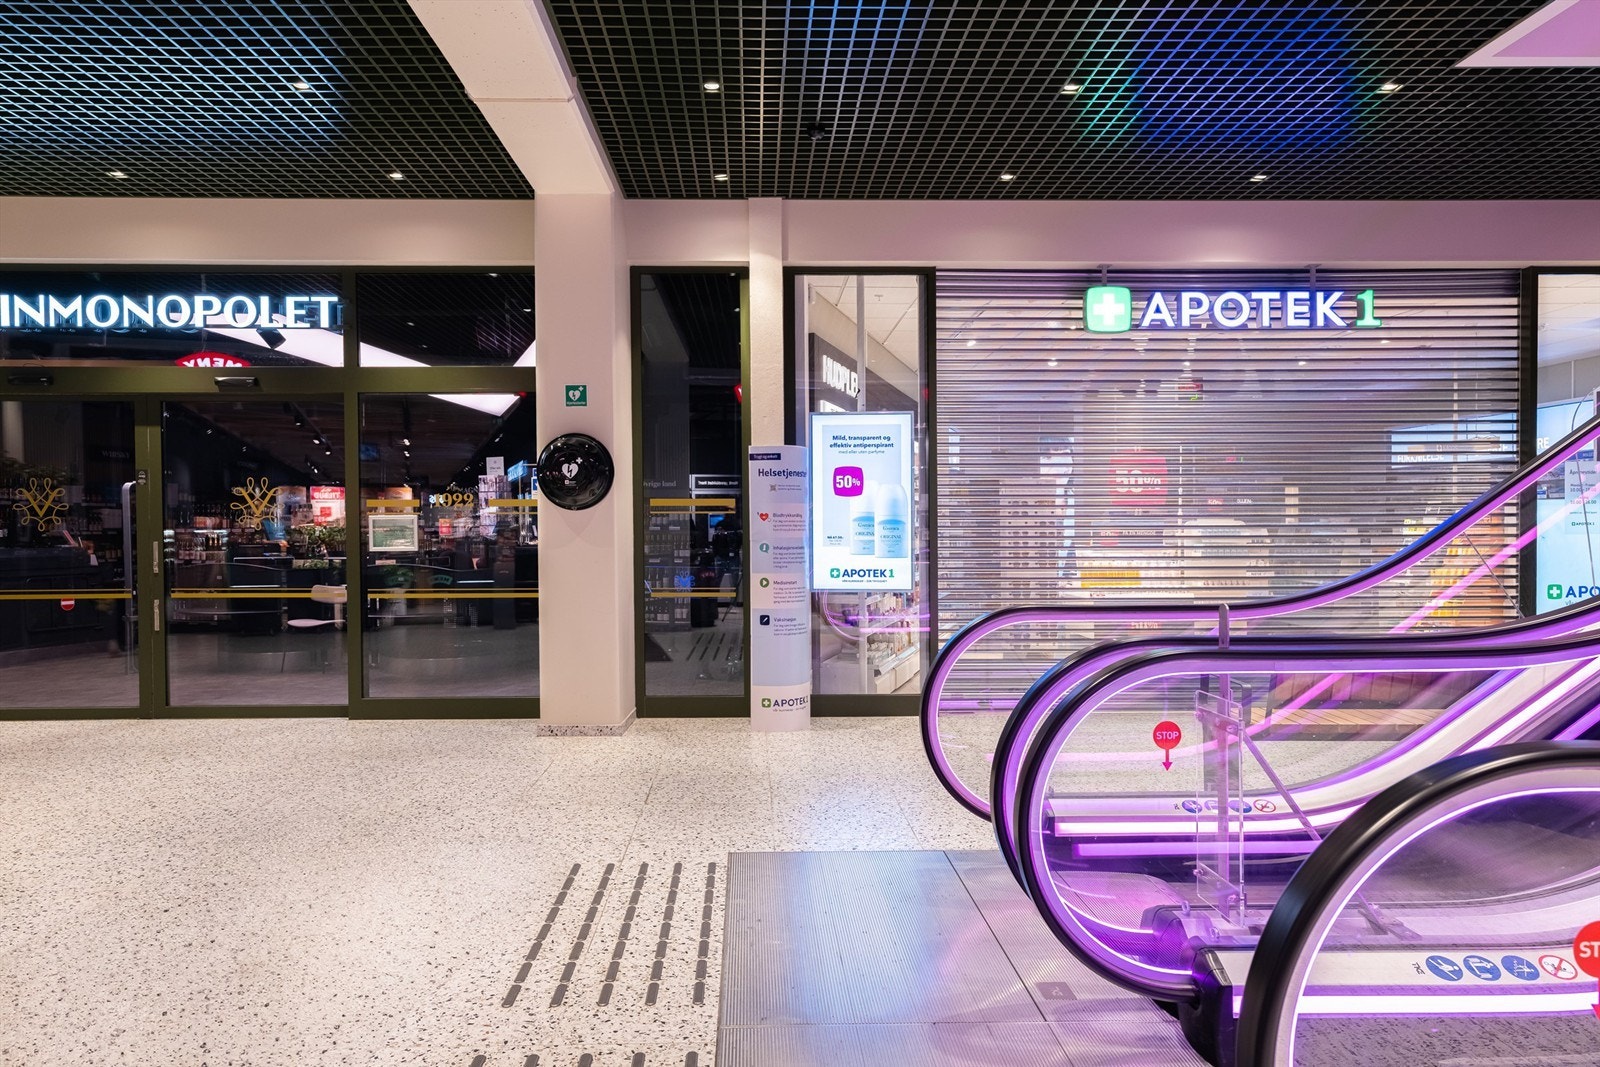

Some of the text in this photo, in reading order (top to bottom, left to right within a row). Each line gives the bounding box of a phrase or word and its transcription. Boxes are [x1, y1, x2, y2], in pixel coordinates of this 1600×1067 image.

[0, 294, 338, 327] INMONOPOLET
[1140, 289, 1383, 327] APOTEK 1
[836, 475, 861, 489] 50%
[433, 492, 475, 508] 1922
[842, 569, 895, 578] APOTEK 1
[1565, 585, 1600, 598] APO
[1156, 731, 1180, 740] STOP
[1578, 940, 1600, 958] ST
